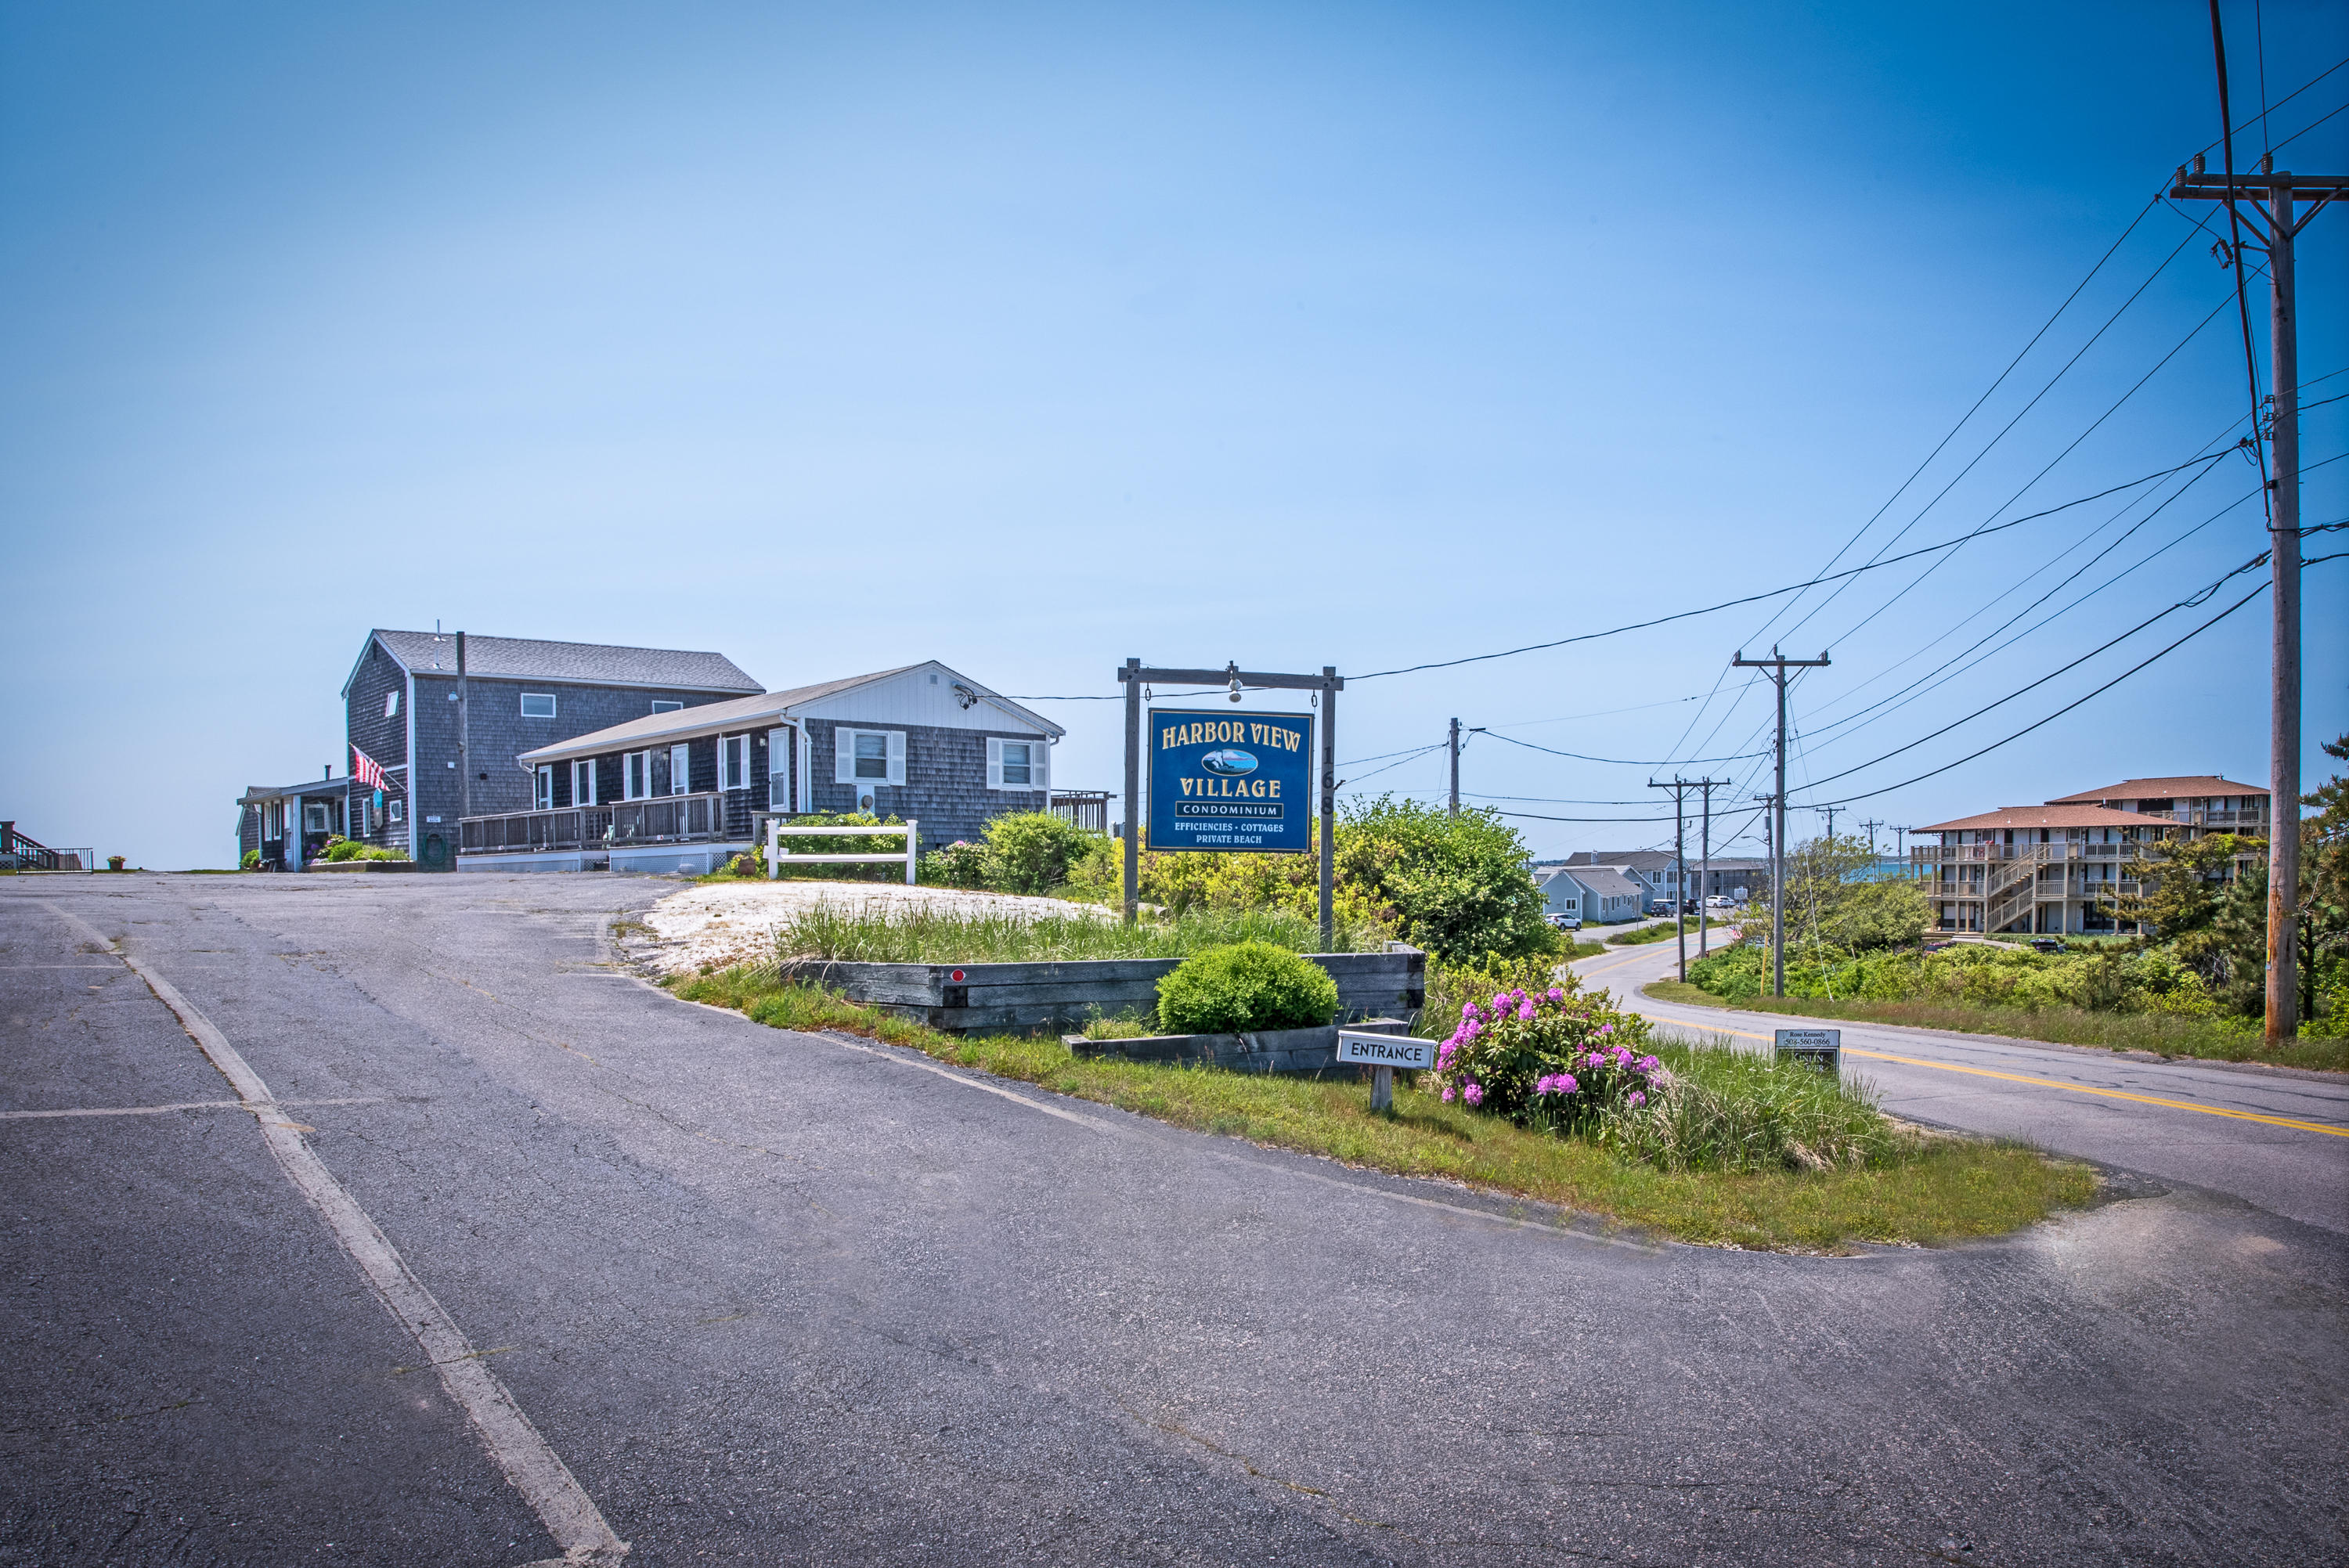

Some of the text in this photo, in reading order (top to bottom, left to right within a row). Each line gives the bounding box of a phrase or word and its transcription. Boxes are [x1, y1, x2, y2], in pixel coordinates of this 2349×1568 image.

[1162, 721, 1301, 752] HARBOR VIEW
[1180, 777, 1281, 798] VILLAGE
[1321, 746, 1334, 815] 168
[1183, 805, 1277, 816] CONDOMINIUM
[1174, 822, 1284, 832] EFFICIENCIES COTTAGES
[1196, 834, 1262, 844] PRIVATE BEACH
[1351, 1042, 1423, 1062] ENTRANCE
